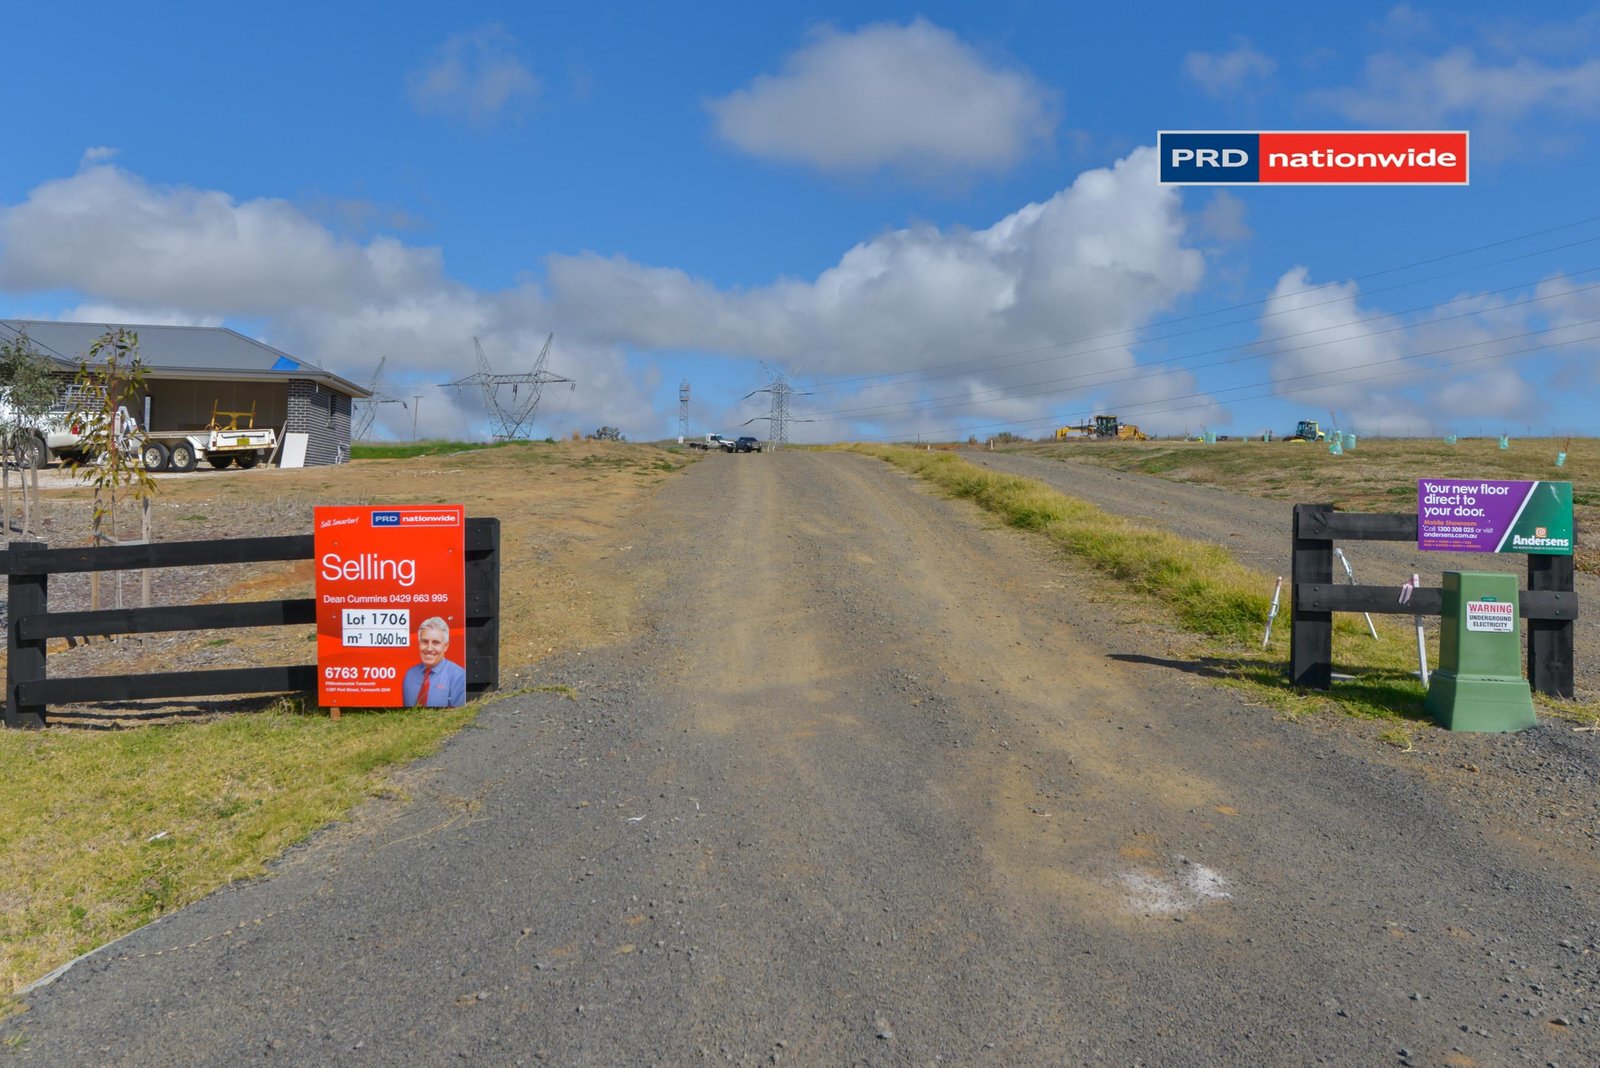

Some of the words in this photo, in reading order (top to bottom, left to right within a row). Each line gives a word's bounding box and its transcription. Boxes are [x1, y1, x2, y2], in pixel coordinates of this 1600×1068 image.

[1424, 482, 1451, 494] Your
[1452, 485, 1478, 494] new
[1480, 483, 1509, 495] floor
[1424, 494, 1460, 505] direct
[1462, 496, 1476, 505] to
[1424, 507, 1452, 518] your
[1454, 505, 1485, 517] door.
[1512, 535, 1569, 546] Andersens
[322, 553, 416, 587] Selling
[323, 595, 346, 603] Dean
[347, 595, 388, 603] Cummins
[389, 594, 411, 603] 0429
[413, 594, 429, 602] 663
[431, 594, 448, 602] 995
[1469, 604, 1512, 613] WARNING
[346, 613, 365, 626] Lot
[372, 613, 407, 625] 1706
[369, 633, 393, 645] 1.060
[395, 632, 407, 644] ha
[325, 667, 359, 679] 6763
[363, 667, 396, 679] 7000
